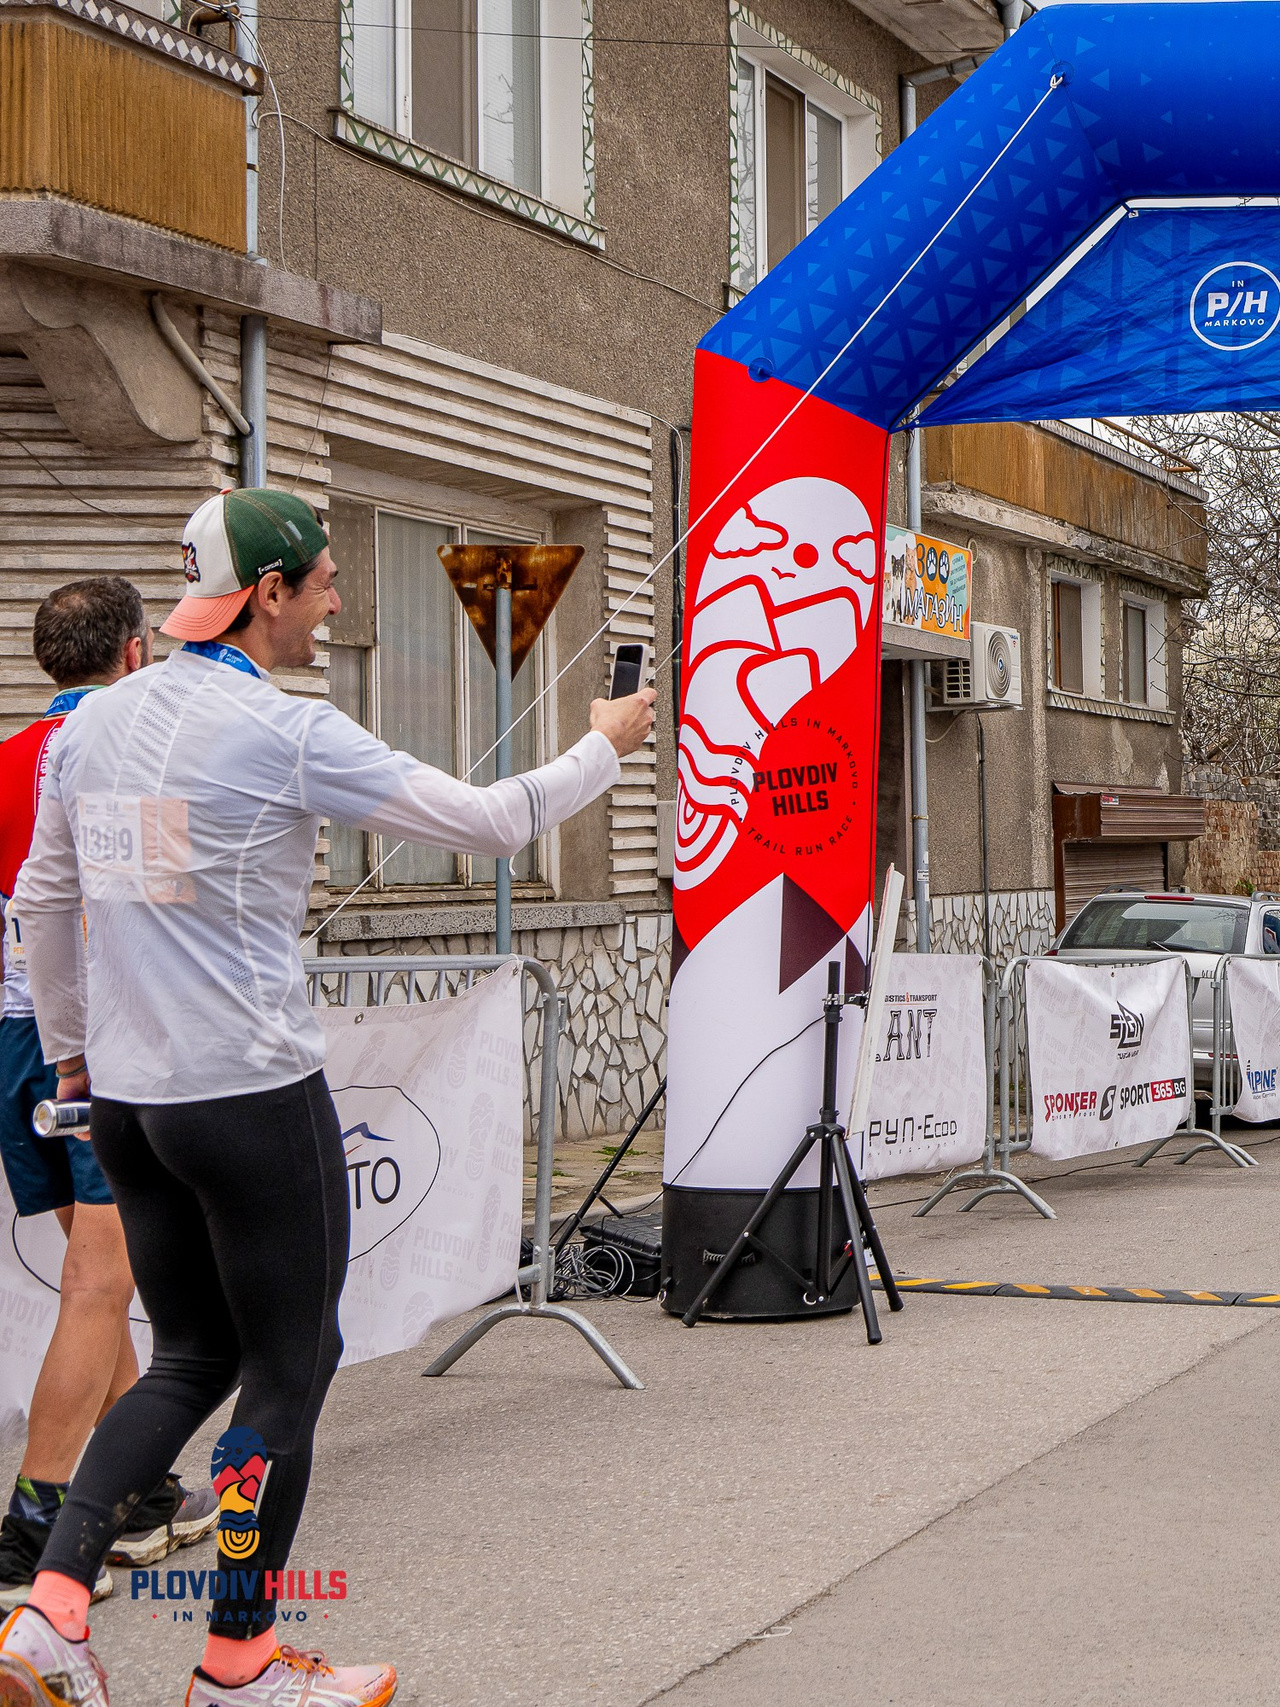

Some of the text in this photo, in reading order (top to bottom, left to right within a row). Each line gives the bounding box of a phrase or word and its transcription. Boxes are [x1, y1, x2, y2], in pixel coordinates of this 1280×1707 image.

[1231, 280, 1244, 288] IN
[1207, 290, 1268, 318] P/H
[1204, 318, 1265, 328] MARKOVO
[905, 587, 963, 632] МАГАЗИН
[806, 718, 821, 730] IN
[752, 762, 838, 793] PLOVDIV
[772, 789, 829, 817] HILLS
[747, 826, 824, 856] TRAIL RUN
[828, 815, 853, 846] RACE
[910, 994, 938, 1002] TRANSPORT
[875, 1008, 938, 1062] ANT
[1043, 1091, 1098, 1123] SPONSER
